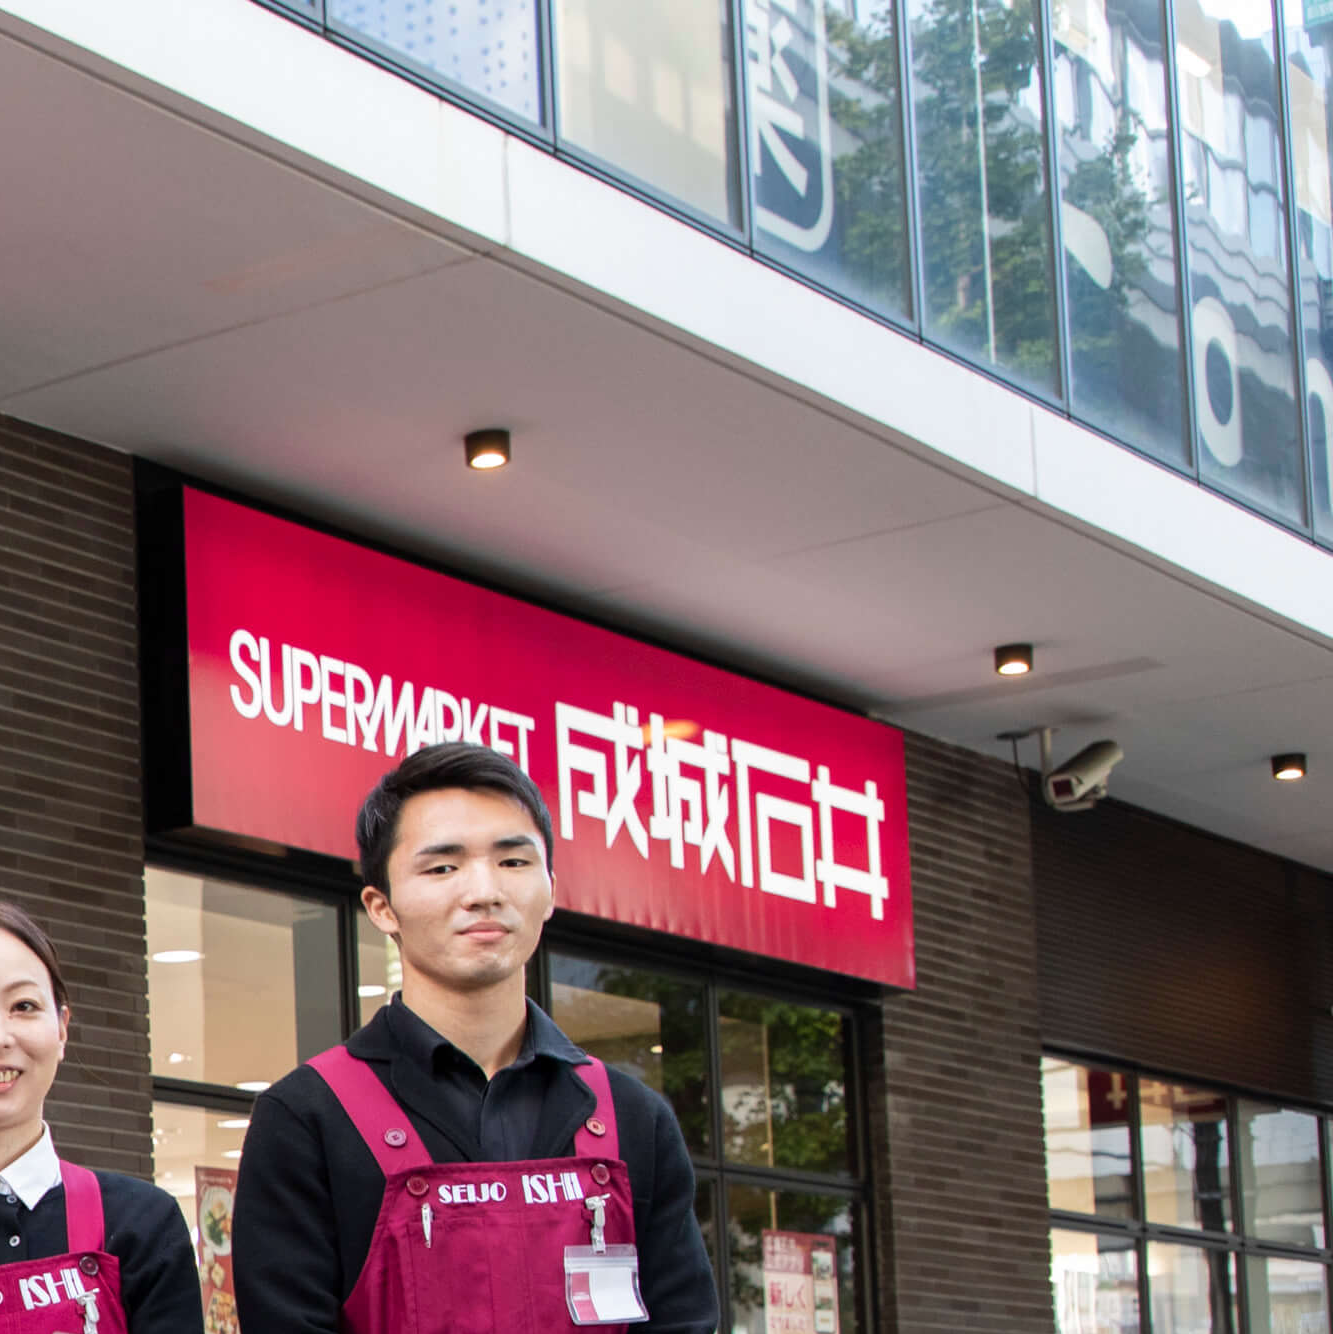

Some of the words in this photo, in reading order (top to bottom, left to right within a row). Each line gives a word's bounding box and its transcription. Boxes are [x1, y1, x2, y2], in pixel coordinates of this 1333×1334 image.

[229, 628, 535, 776] SUPERMARKET
[555, 701, 889, 920] 成城石井
[438, 1181, 507, 1204] SEIJO
[521, 1171, 585, 1205] ISHII
